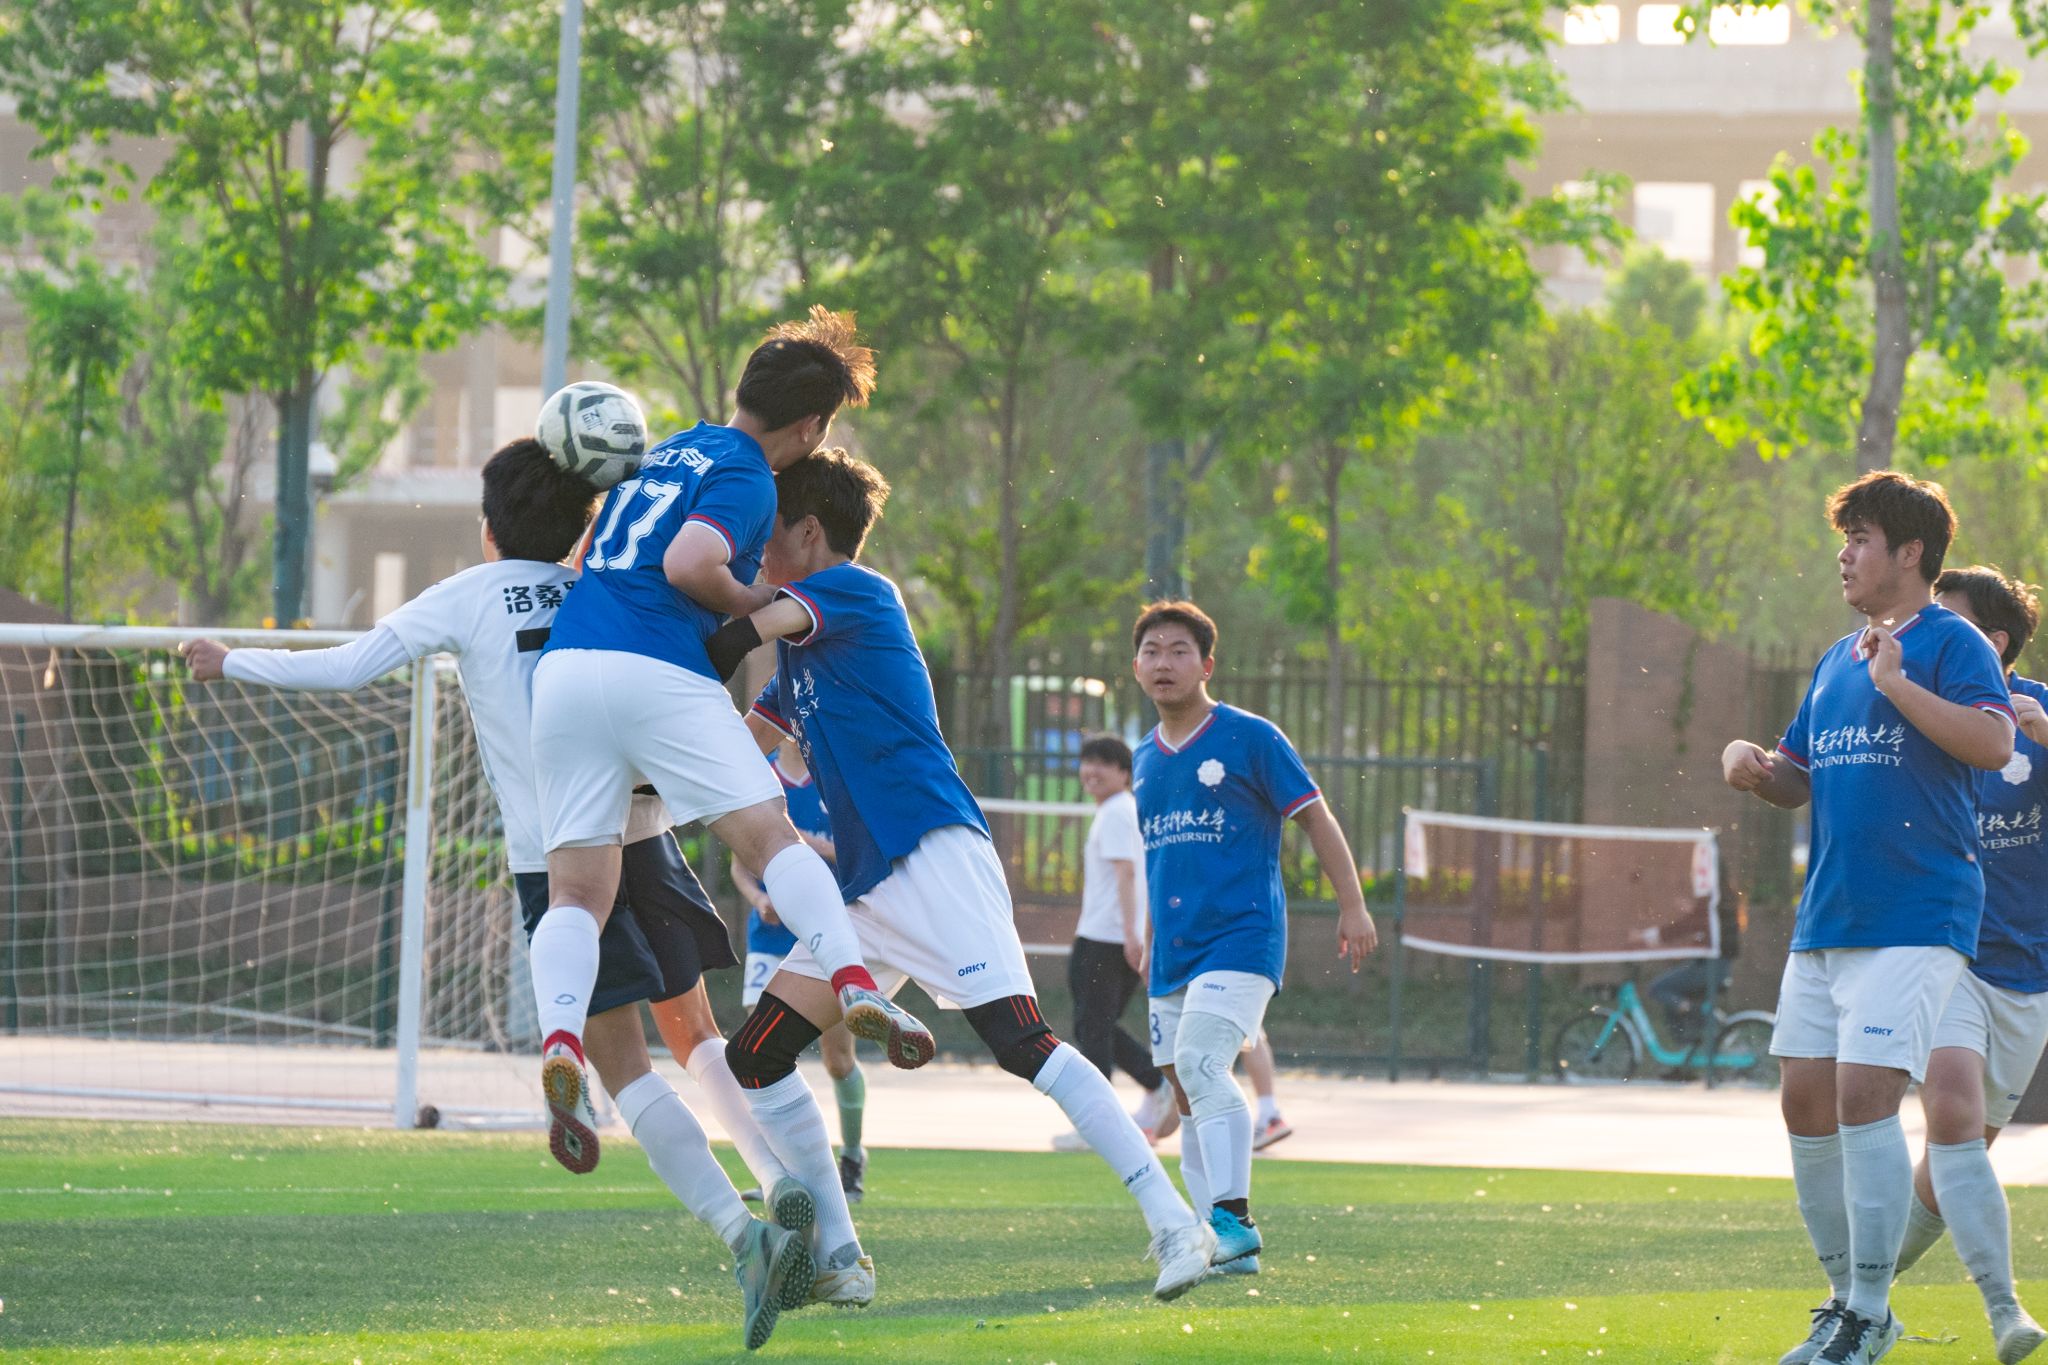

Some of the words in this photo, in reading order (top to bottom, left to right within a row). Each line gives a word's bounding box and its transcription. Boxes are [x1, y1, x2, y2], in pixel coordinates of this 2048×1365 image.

[585, 476, 683, 572] 17
[503, 580, 577, 615] 洛桑
[1824, 752, 1903, 768] UNIVERSITY
[957, 961, 987, 977] ORKY
[1863, 1025, 1894, 1036] ORKY
